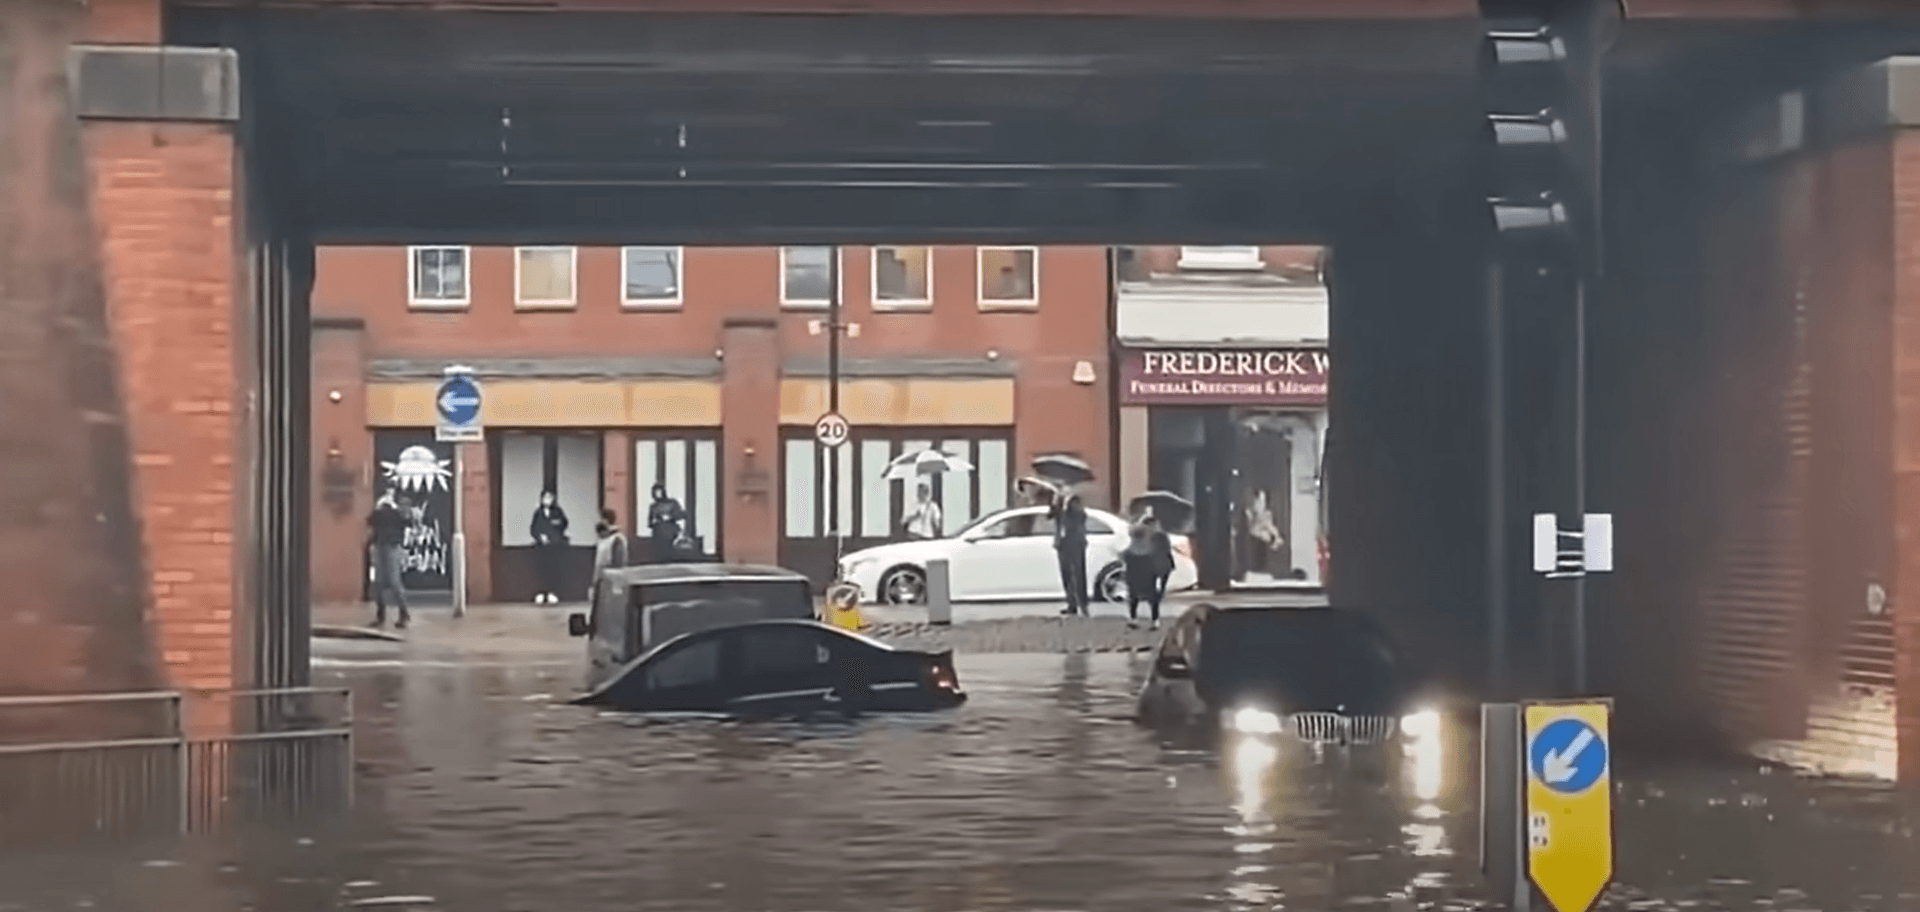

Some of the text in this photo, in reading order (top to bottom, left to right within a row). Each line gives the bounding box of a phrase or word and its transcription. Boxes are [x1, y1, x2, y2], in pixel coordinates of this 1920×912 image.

[1144, 352, 1307, 375] FREDERICK
[1264, 379, 1276, 395] &
[819, 422, 845, 438] 20
